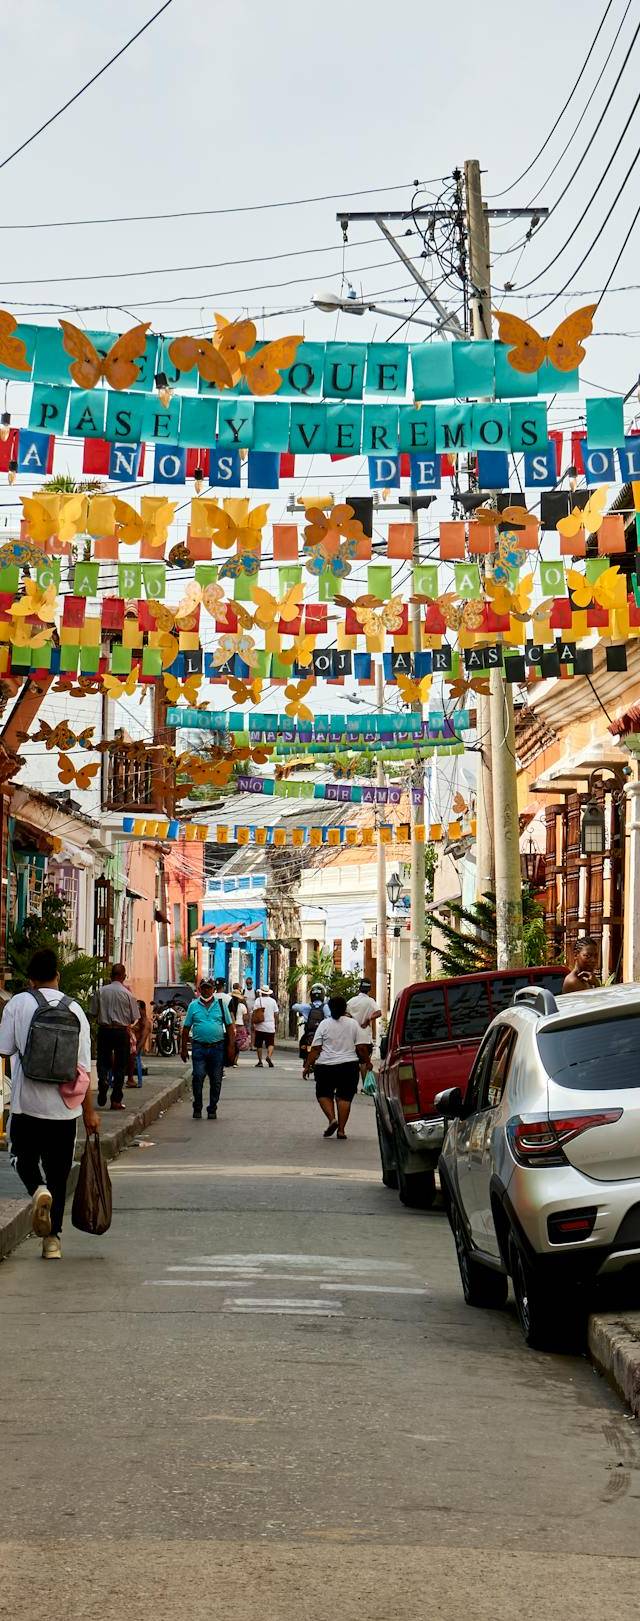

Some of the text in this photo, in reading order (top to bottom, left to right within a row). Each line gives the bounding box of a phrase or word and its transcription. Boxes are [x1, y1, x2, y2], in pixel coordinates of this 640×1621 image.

[288, 363, 398, 396] QUE
[40, 402, 539, 449] PASE Y VEREMOS
[22, 441, 234, 480] AÑOS
[375, 459, 437, 484] DE
[38, 569, 162, 597] GABO
[417, 568, 561, 594] GAO
[188, 645, 574, 674] LA OJARASCA
[239, 779, 262, 791] NO
[327, 789, 350, 800] DE
[364, 790, 422, 803] AMOR
